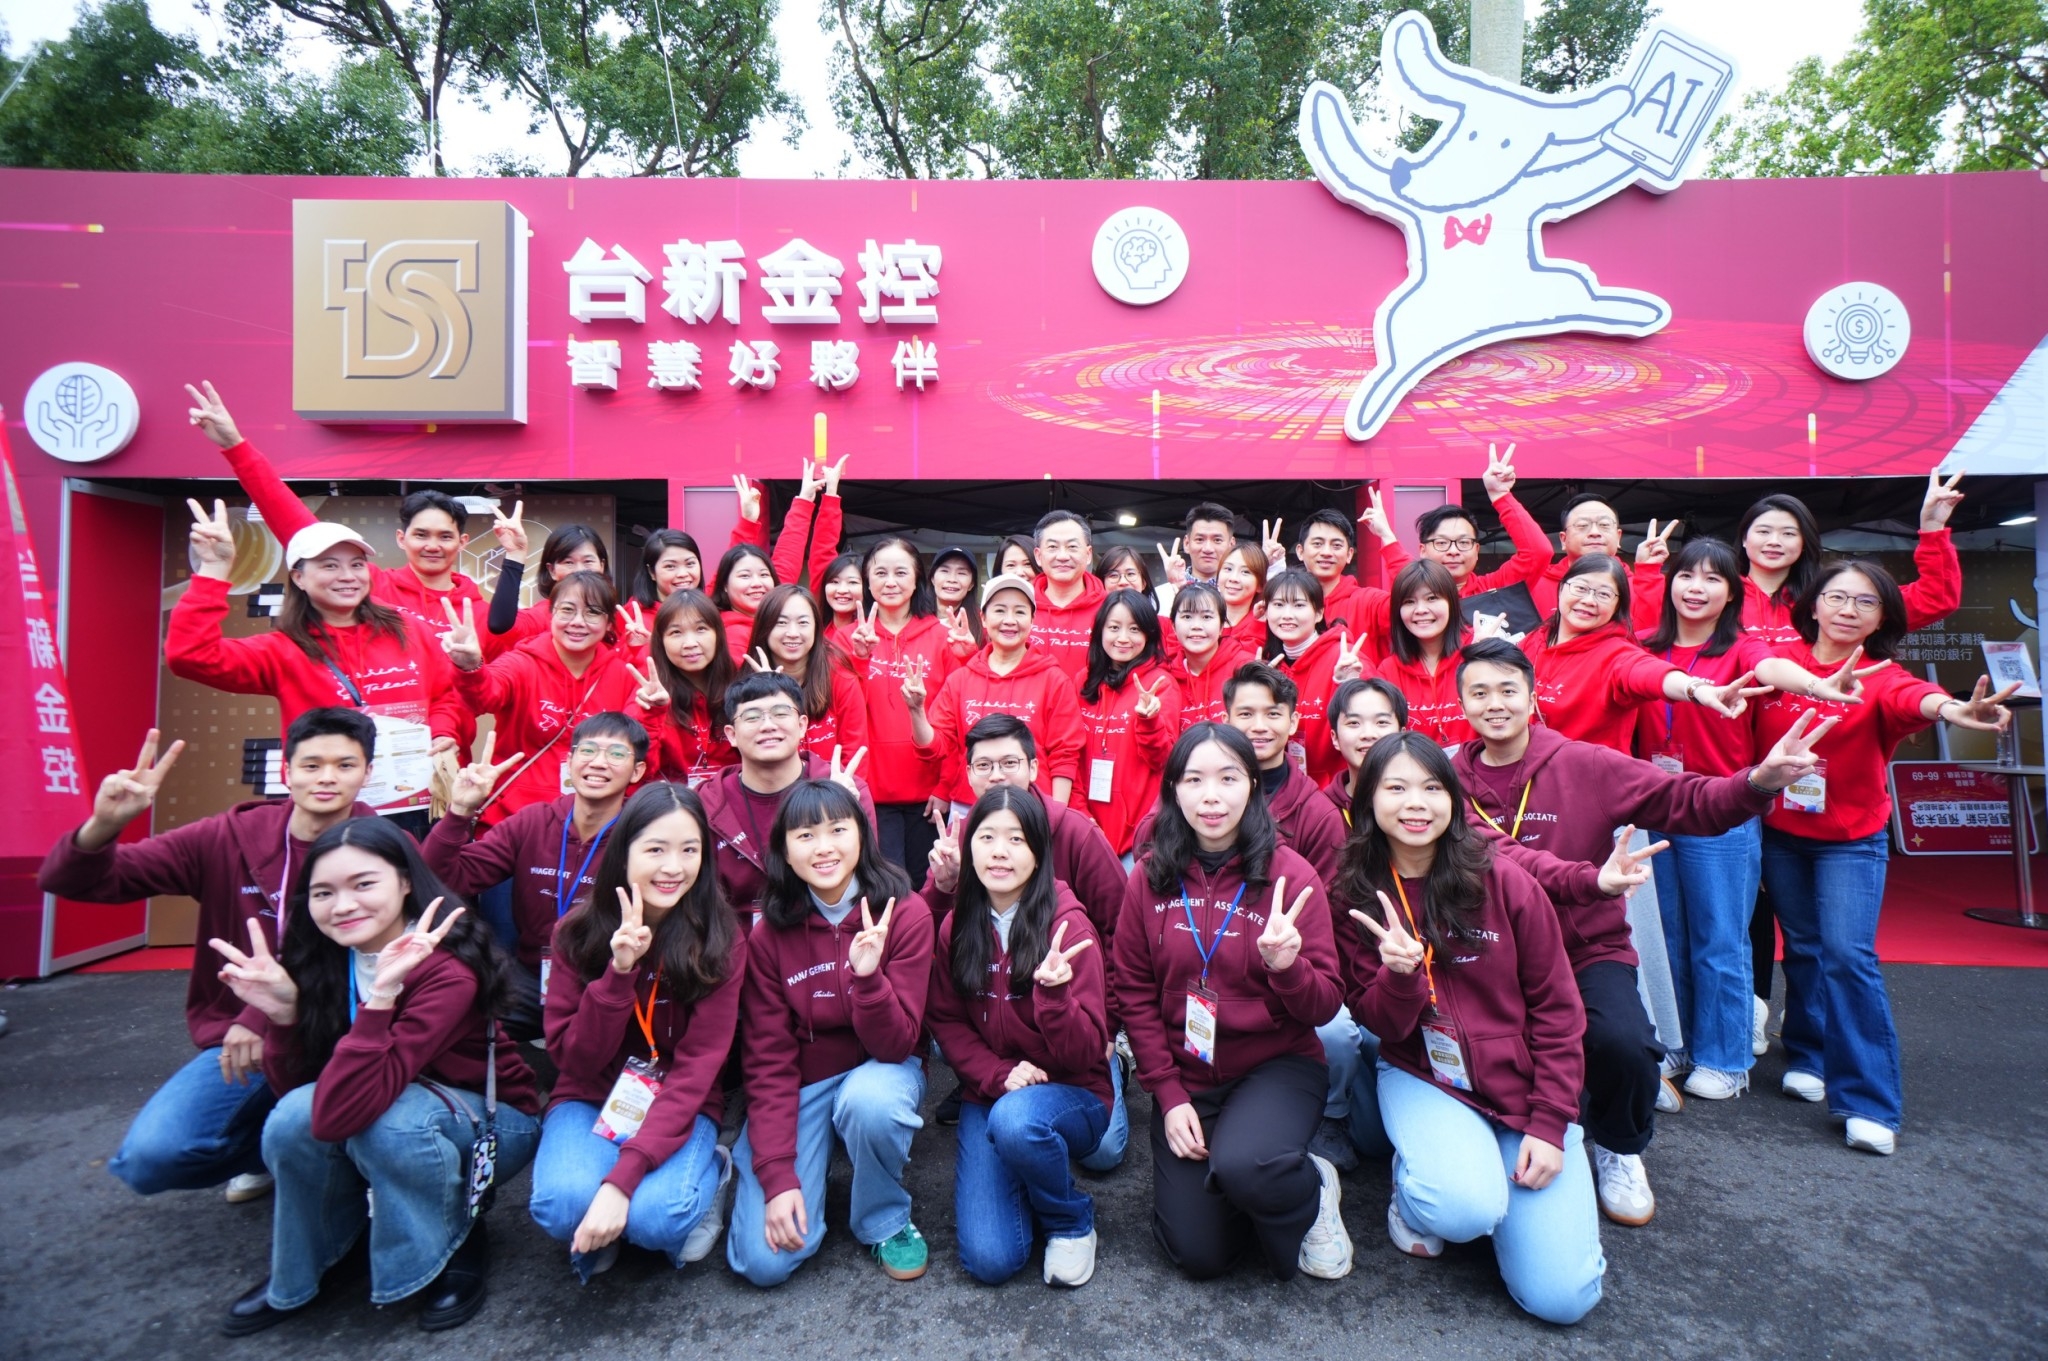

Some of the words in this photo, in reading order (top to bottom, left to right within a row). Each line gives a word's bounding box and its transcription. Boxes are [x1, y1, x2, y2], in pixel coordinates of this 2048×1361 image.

[1631, 71, 1704, 139] AI
[562, 236, 943, 326] 台新金控
[566, 338, 941, 392] 智慧好夥伴
